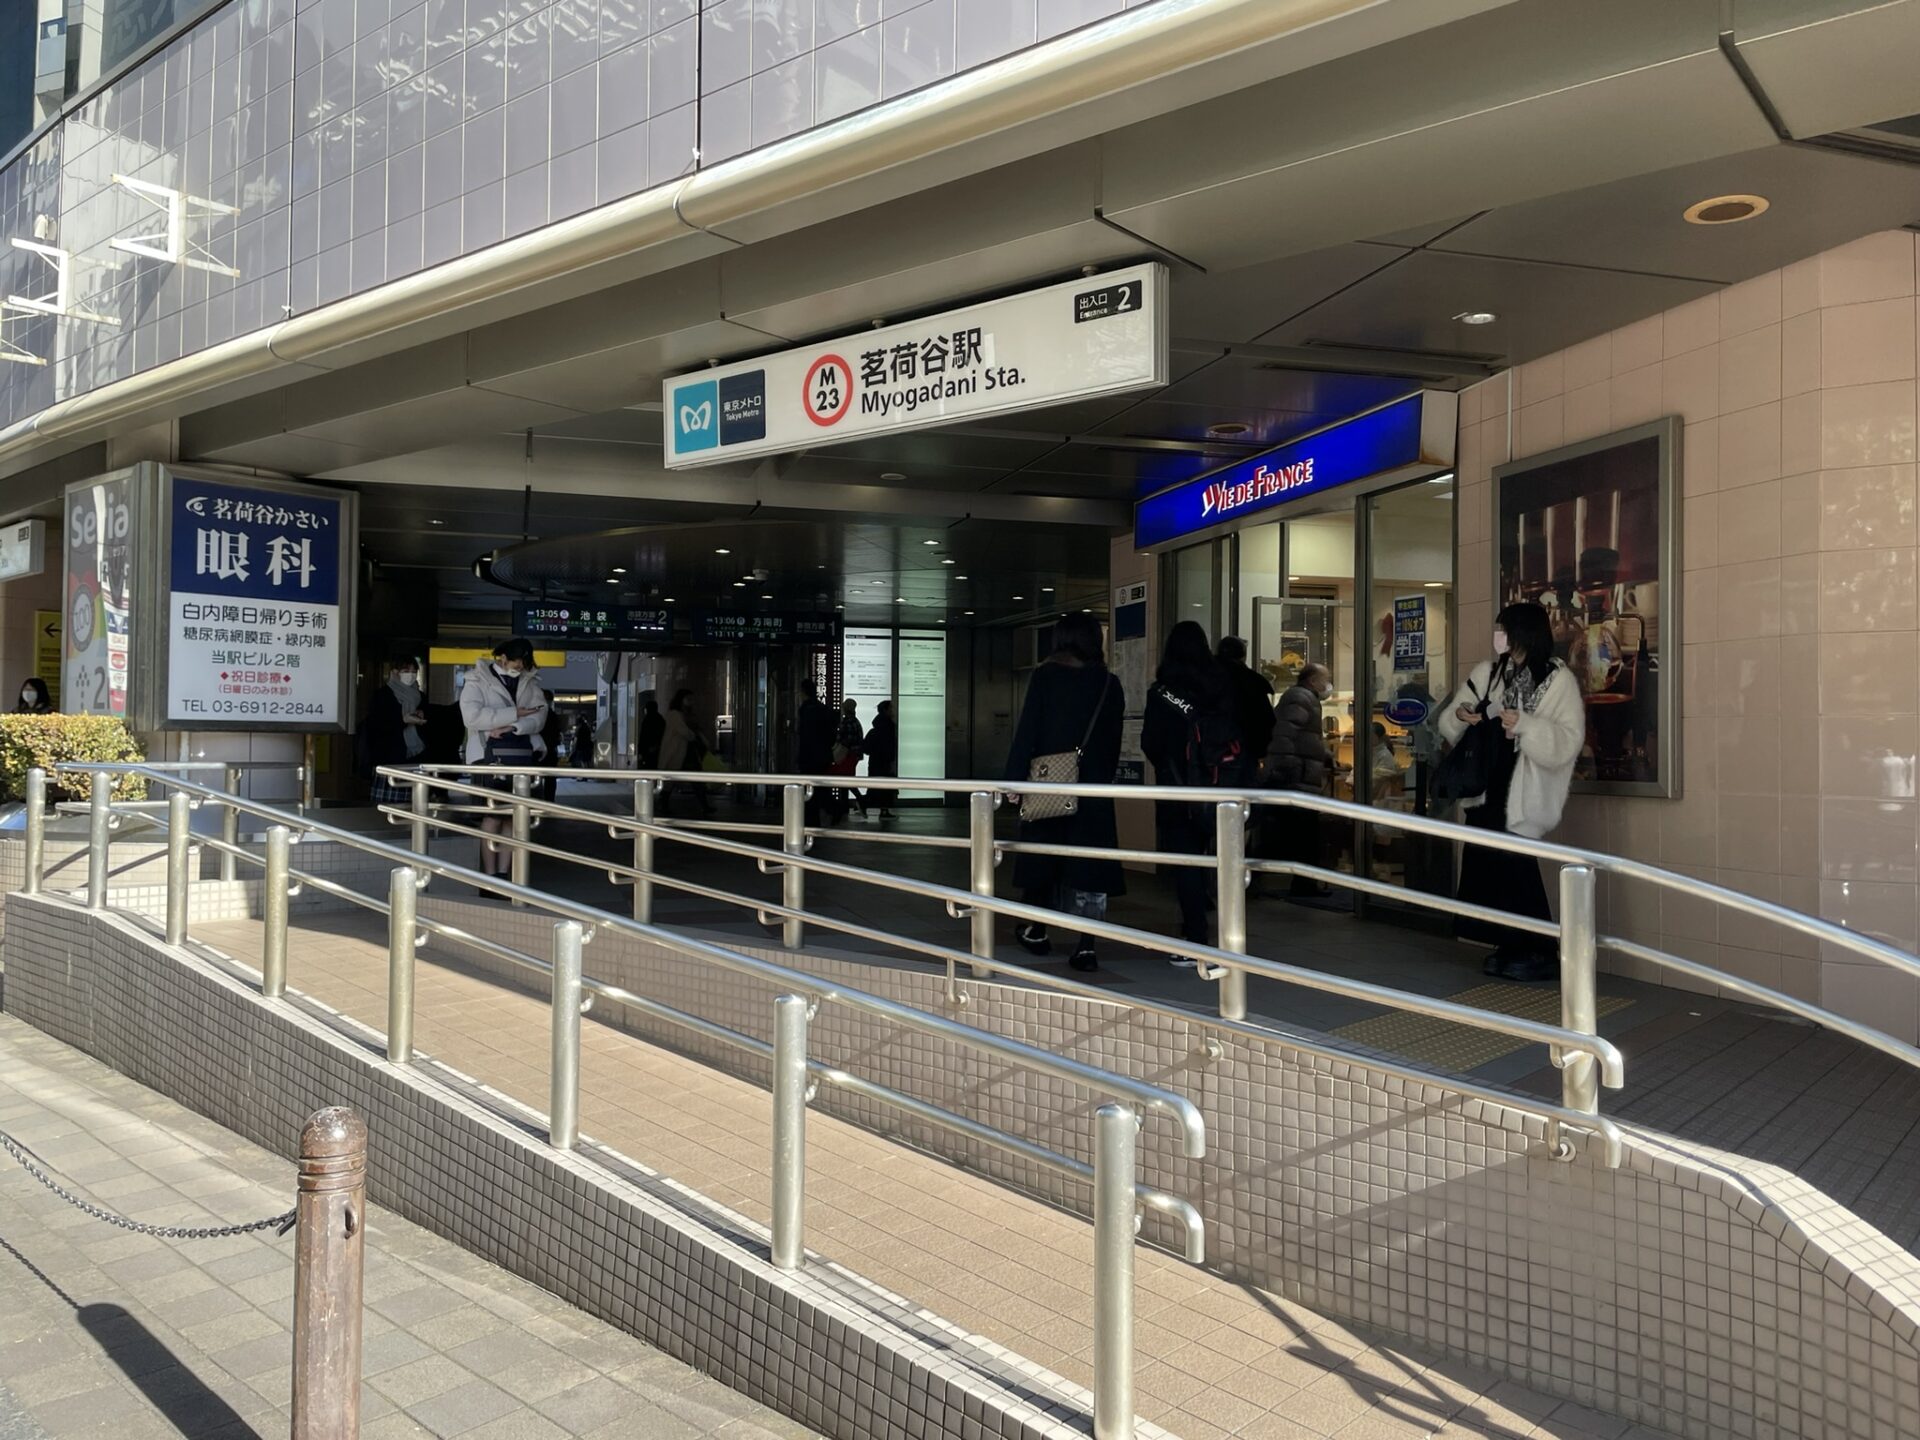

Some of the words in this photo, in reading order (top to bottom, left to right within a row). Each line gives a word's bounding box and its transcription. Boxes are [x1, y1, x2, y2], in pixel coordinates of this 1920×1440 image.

[1079, 293, 1108, 309] 出入口
[1117, 286, 1132, 311] 2
[860, 327, 982, 388] 茗荷谷駅
[819, 366, 836, 388] M
[816, 387, 840, 412] 23
[861, 369, 977, 416] Myogadani
[984, 366, 1026, 390] Sta.
[723, 395, 762, 412] 東京メトロ
[725, 412, 742, 422] Tokyo
[742, 409, 760, 419] Metro
[1253, 457, 1314, 500] FRANCE
[70, 494, 129, 549] Seia
[212, 497, 329, 529] 茗荷谷かさい
[196, 527, 317, 588] 眼科
[182, 602, 328, 629] 白内障日帰り手術
[535, 609, 559, 618] 13:05
[580, 610, 607, 621] 池袋
[657, 610, 668, 625] 2
[714, 617, 736, 625] 13:06
[752, 617, 783, 627] 方南町
[183, 626, 326, 648] 糖尿病網膜症・緑内障
[535, 624, 558, 632] 13:10
[1396, 632, 1425, 656] 学割
[211, 650, 301, 668] 当駅ビル2階
[231, 670, 282, 684] 祝日診療
[182, 699, 208, 712] TEL
[212, 700, 324, 715] 03-6912-2844
